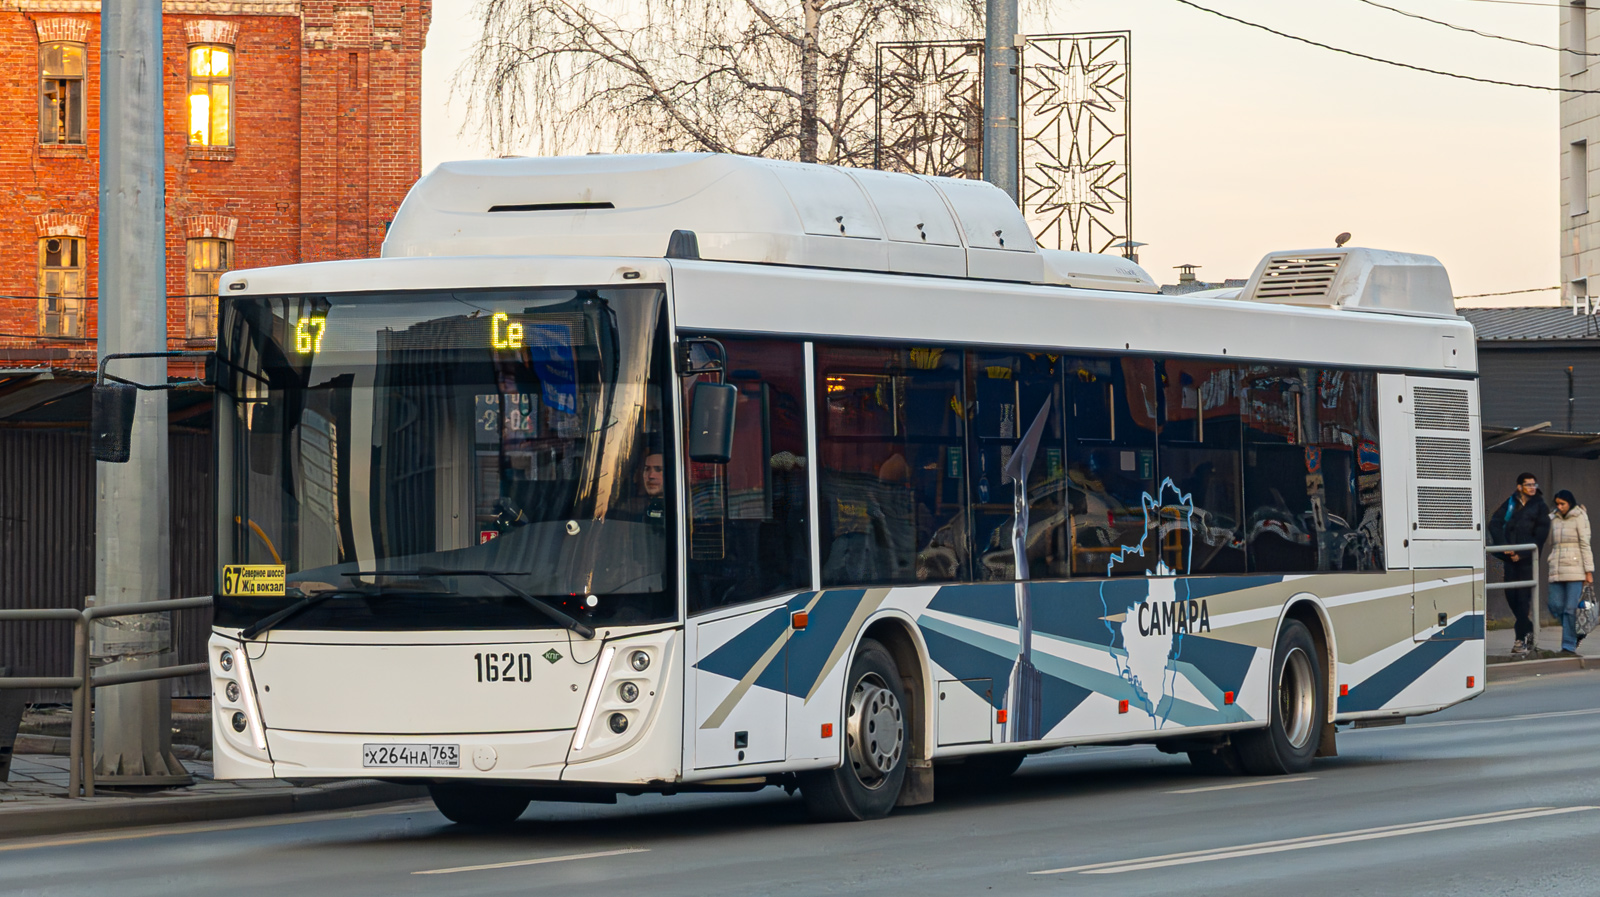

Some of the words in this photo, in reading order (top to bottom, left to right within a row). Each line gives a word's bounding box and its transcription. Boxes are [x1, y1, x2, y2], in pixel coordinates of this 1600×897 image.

[296, 318, 326, 353] 67
[492, 311, 524, 349] Се
[224, 567, 242, 595] 67
[242, 567, 266, 580] Северное
[266, 570, 284, 578] шоссе
[242, 580, 255, 594] Ж/д
[256, 583, 284, 592] вокзал
[1138, 599, 1210, 637] САМАРА
[474, 653, 532, 683] 1620
[368, 747, 429, 765] Х264НА
[431, 746, 456, 760] 763
